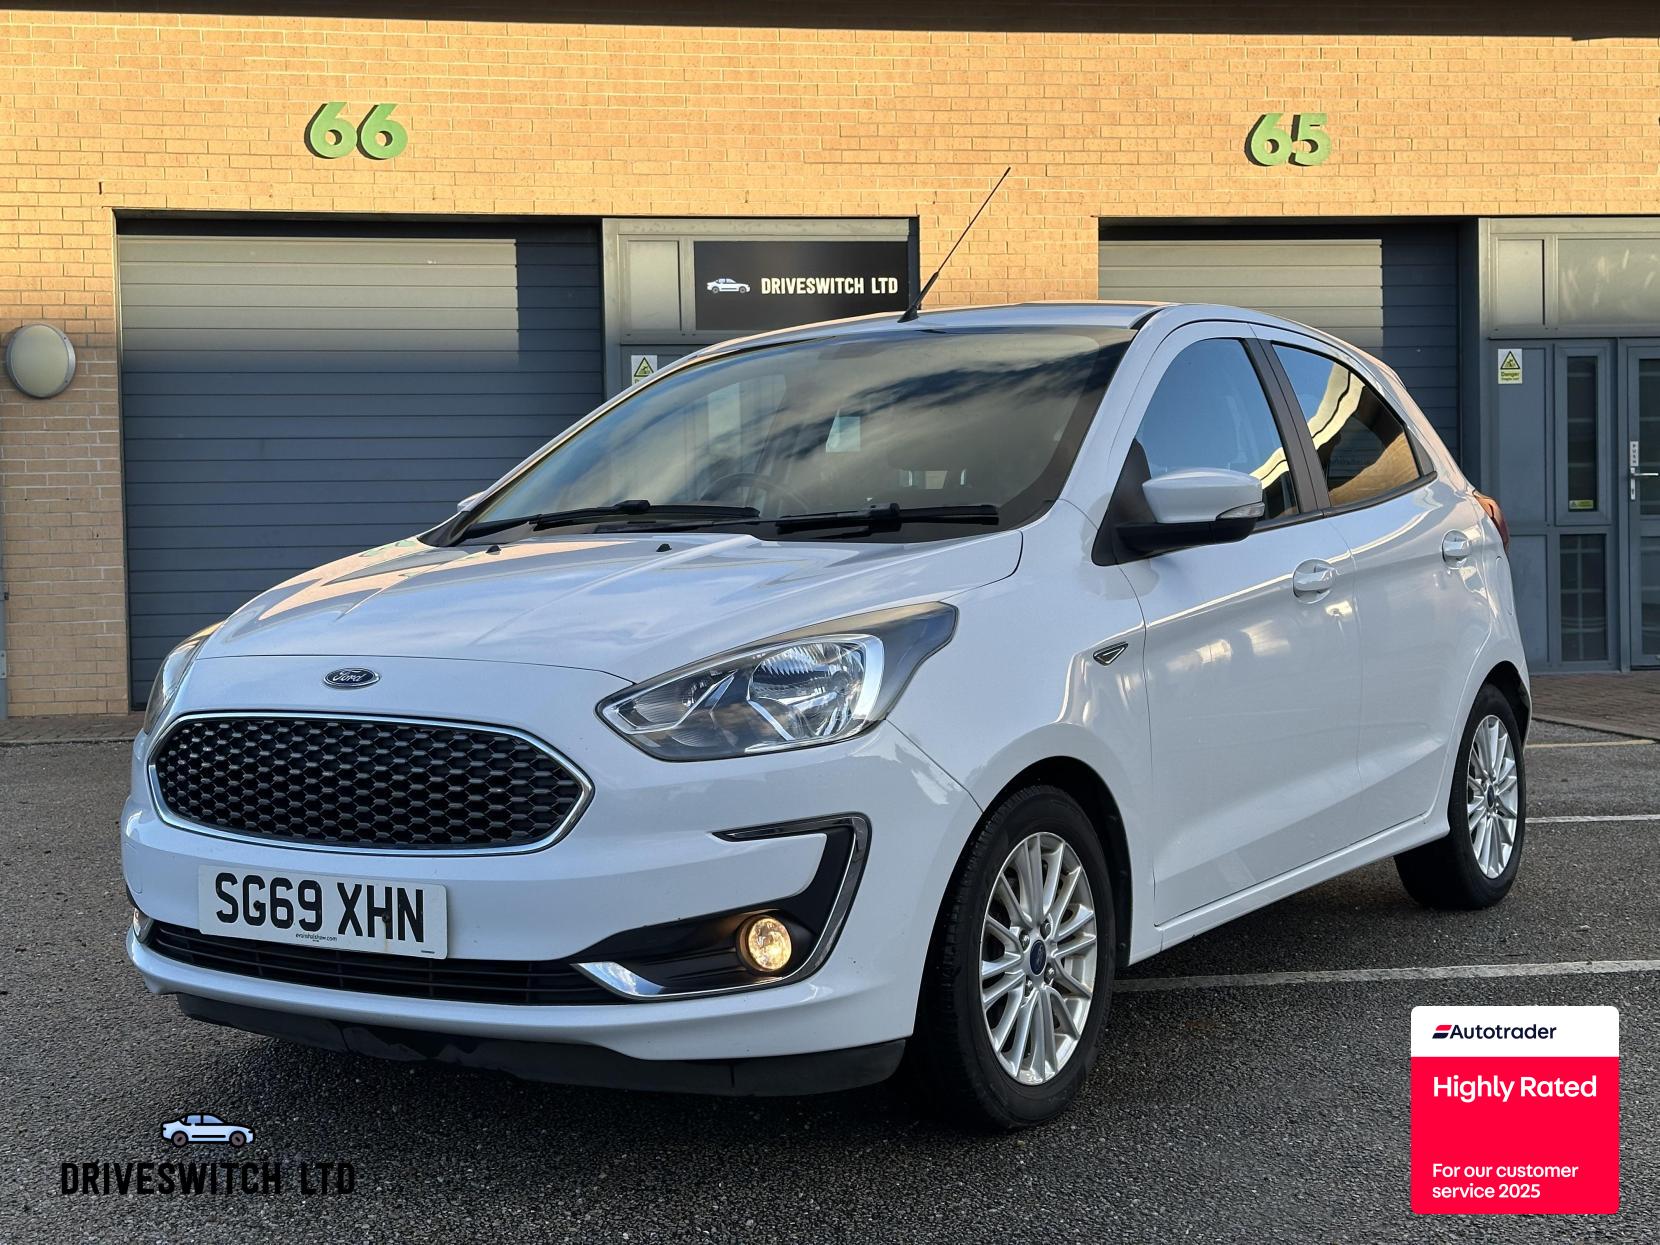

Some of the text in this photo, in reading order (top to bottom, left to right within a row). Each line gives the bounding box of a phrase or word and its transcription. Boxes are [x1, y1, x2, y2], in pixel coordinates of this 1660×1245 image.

[304, 101, 409, 160] 66
[1245, 112, 1332, 167] 65
[761, 277, 899, 294] DRIVESWITCH LTD
[215, 872, 424, 943] SG69 XHN
